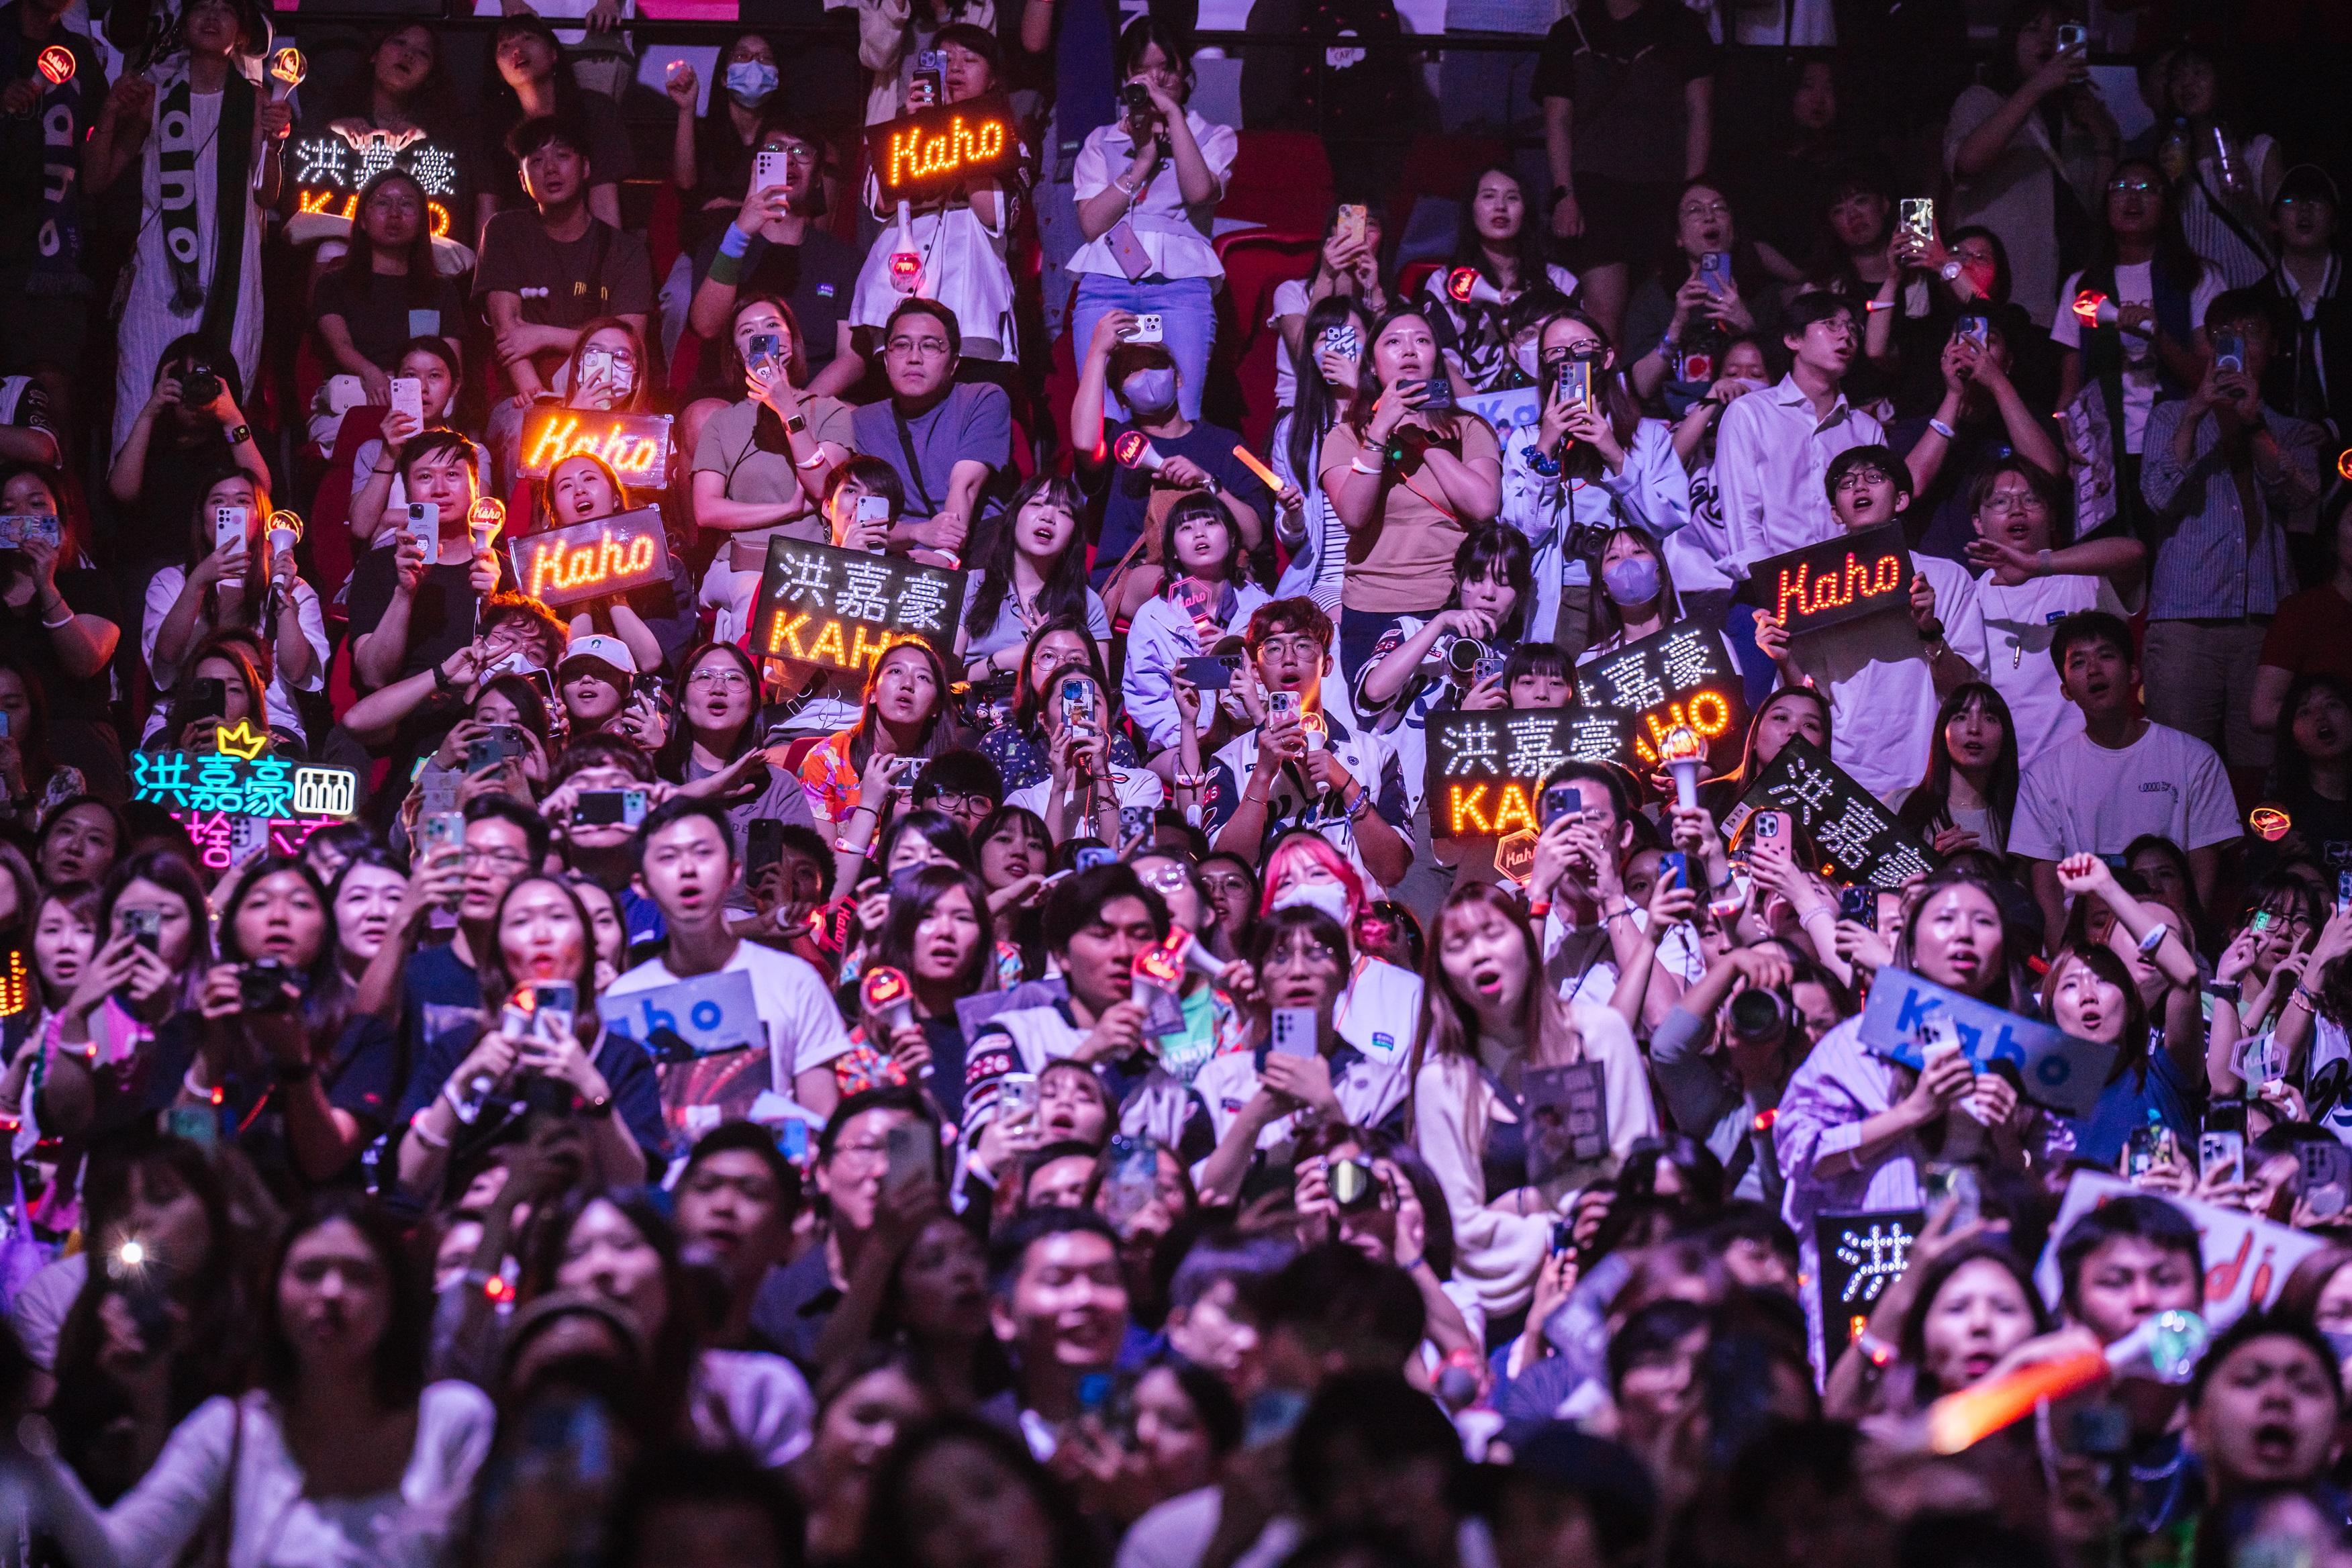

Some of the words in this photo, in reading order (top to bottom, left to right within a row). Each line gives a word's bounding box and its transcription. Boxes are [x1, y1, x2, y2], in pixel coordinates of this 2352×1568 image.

[296, 138, 456, 195] 洪嘉豪
[890, 113, 1003, 186] Kaho
[527, 416, 658, 471] Kaho
[1120, 436, 1140, 463] Kaho
[473, 506, 502, 520] Kaho
[530, 528, 655, 597] Kaho
[774, 552, 949, 631] 洪嘉豪
[1778, 552, 1900, 626] Kaho
[768, 609, 892, 669] KAH
[1441, 715, 1622, 777] 洪嘉豪
[134, 751, 295, 819] 洪嘉豪
[1767, 756, 1934, 888] 洪嘉豪
